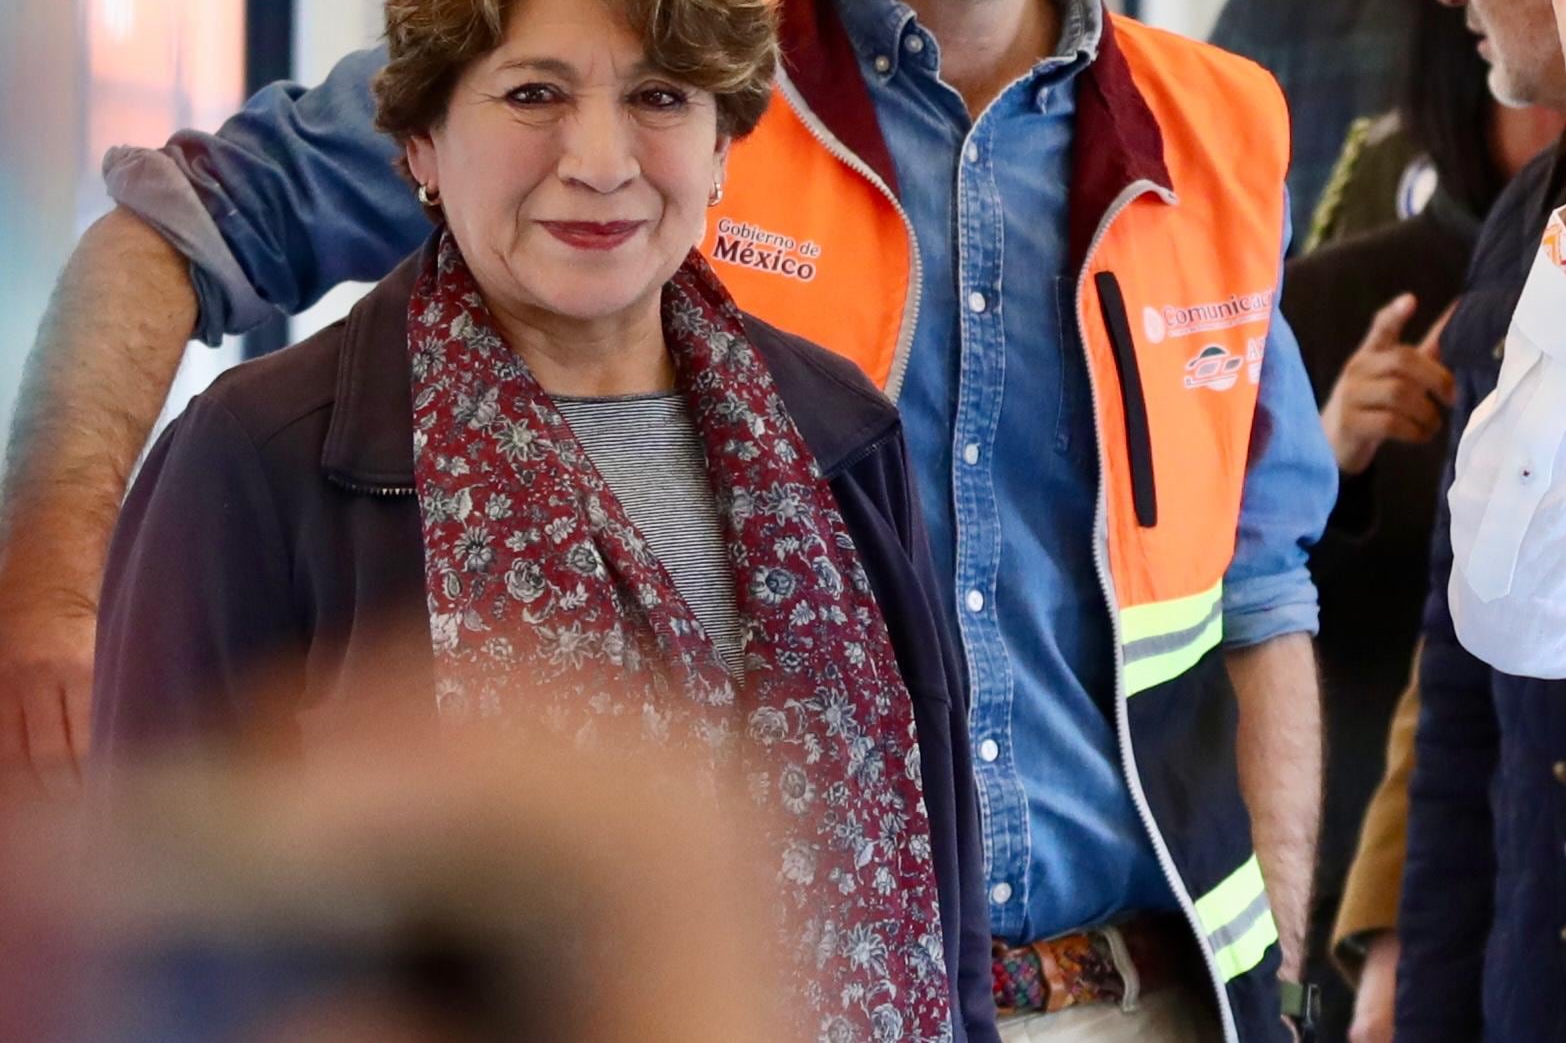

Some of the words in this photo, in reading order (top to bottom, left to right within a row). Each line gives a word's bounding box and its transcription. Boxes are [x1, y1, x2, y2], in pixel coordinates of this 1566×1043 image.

[713, 235, 815, 280] México
[718, 218, 795, 250] Gobierno
[799, 241, 819, 257] de
